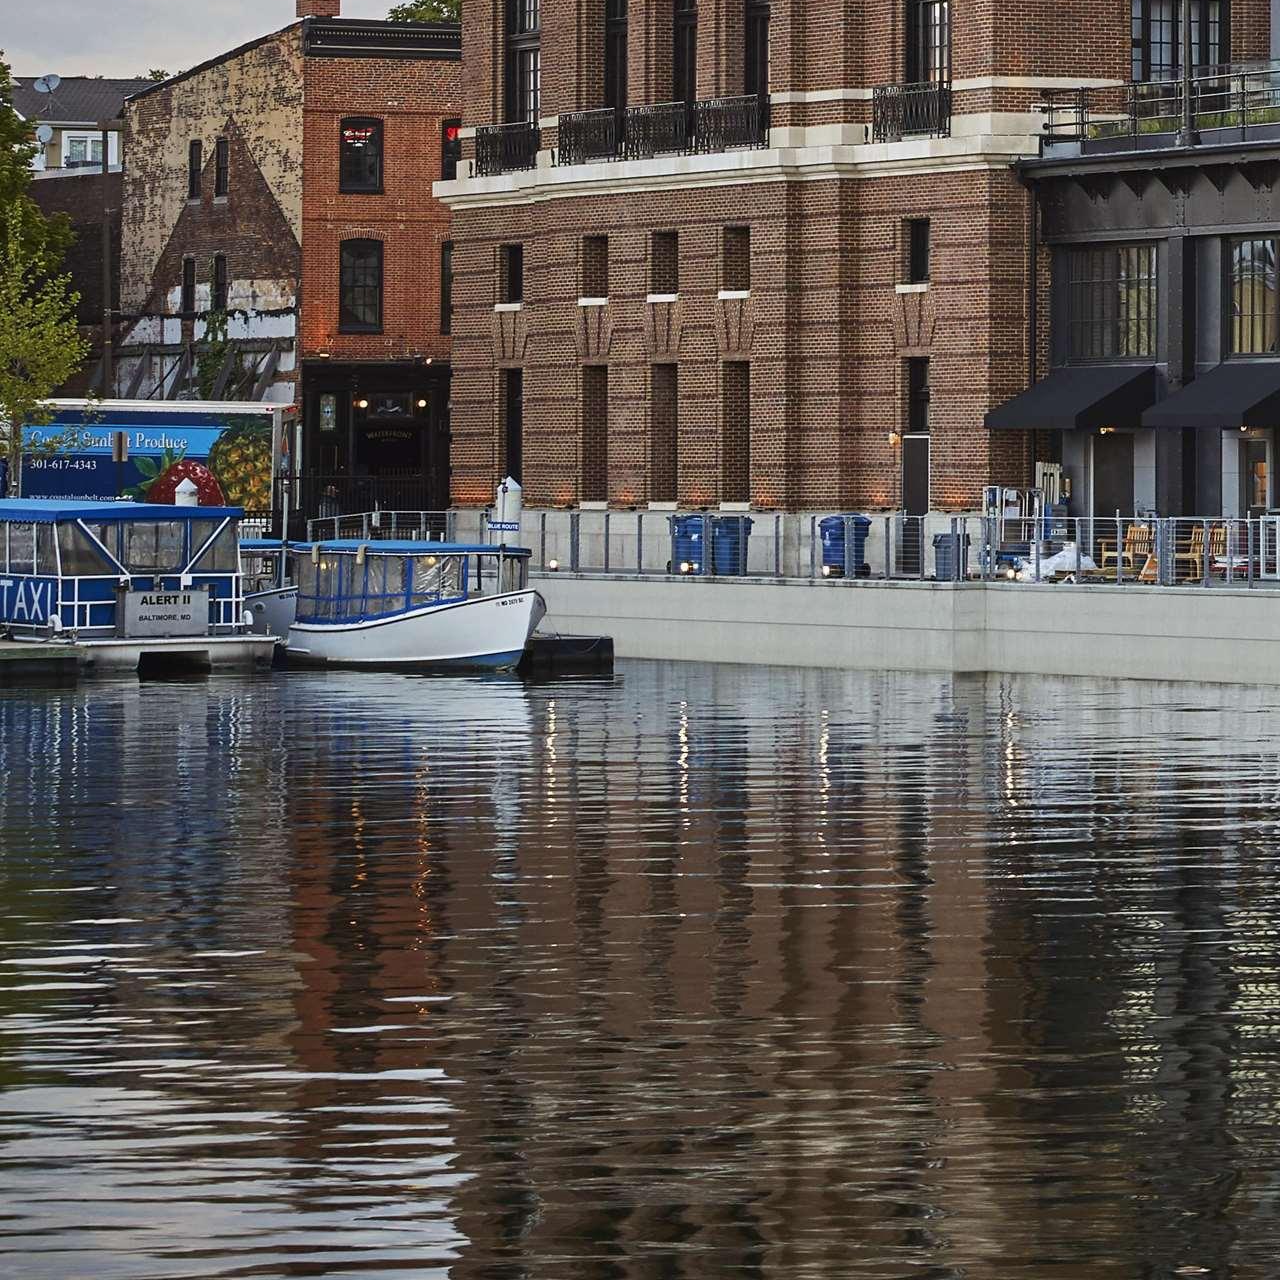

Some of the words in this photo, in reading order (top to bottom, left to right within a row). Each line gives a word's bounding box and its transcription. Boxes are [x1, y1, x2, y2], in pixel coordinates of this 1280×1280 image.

[83, 431, 131, 448] Sunbt
[136, 432, 188, 449] Produce
[30, 458, 97, 471] 301-617-4343
[0, 579, 52, 621] TAXI
[140, 595, 179, 605] ALERT
[183, 594, 191, 605] II
